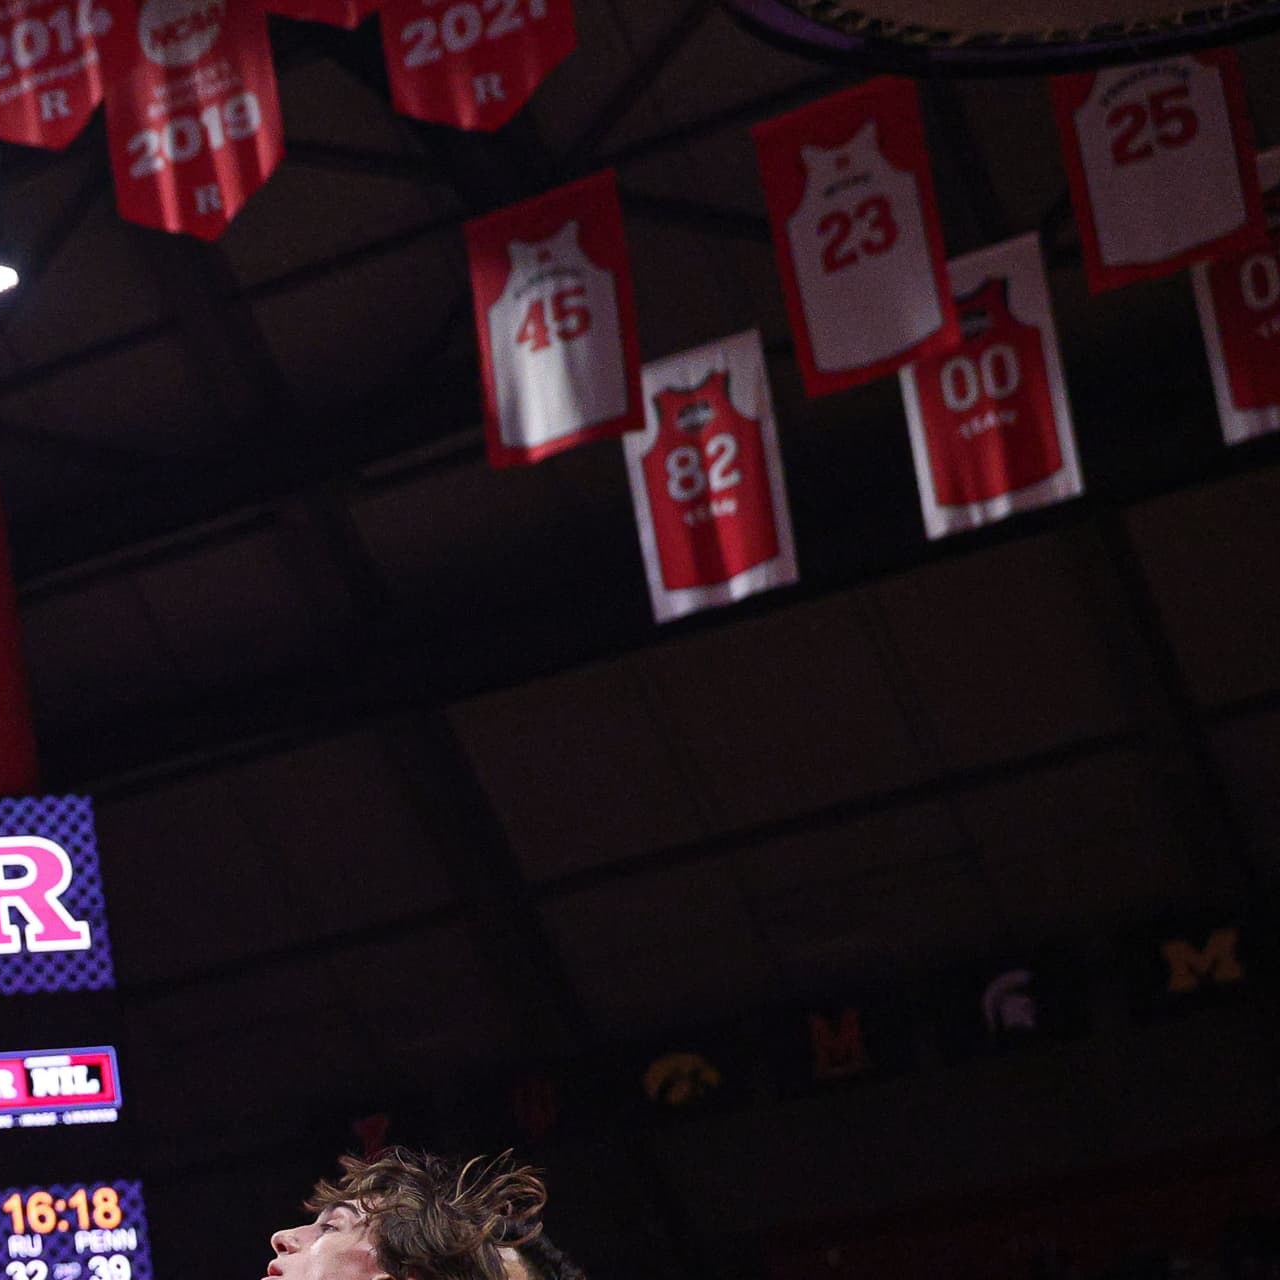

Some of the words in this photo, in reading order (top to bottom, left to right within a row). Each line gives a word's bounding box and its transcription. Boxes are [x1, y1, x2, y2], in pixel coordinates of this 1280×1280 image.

[127, 92, 262, 178] 2019
[1105, 83, 1198, 166] 25
[816, 194, 898, 274] 23
[515, 286, 592, 352] 45
[941, 345, 1020, 412] 00
[663, 433, 741, 501] 82
[2, 1186, 123, 1235] 16:18
[7, 1233, 43, 1258] RU
[74, 1226, 138, 1254] PENN
